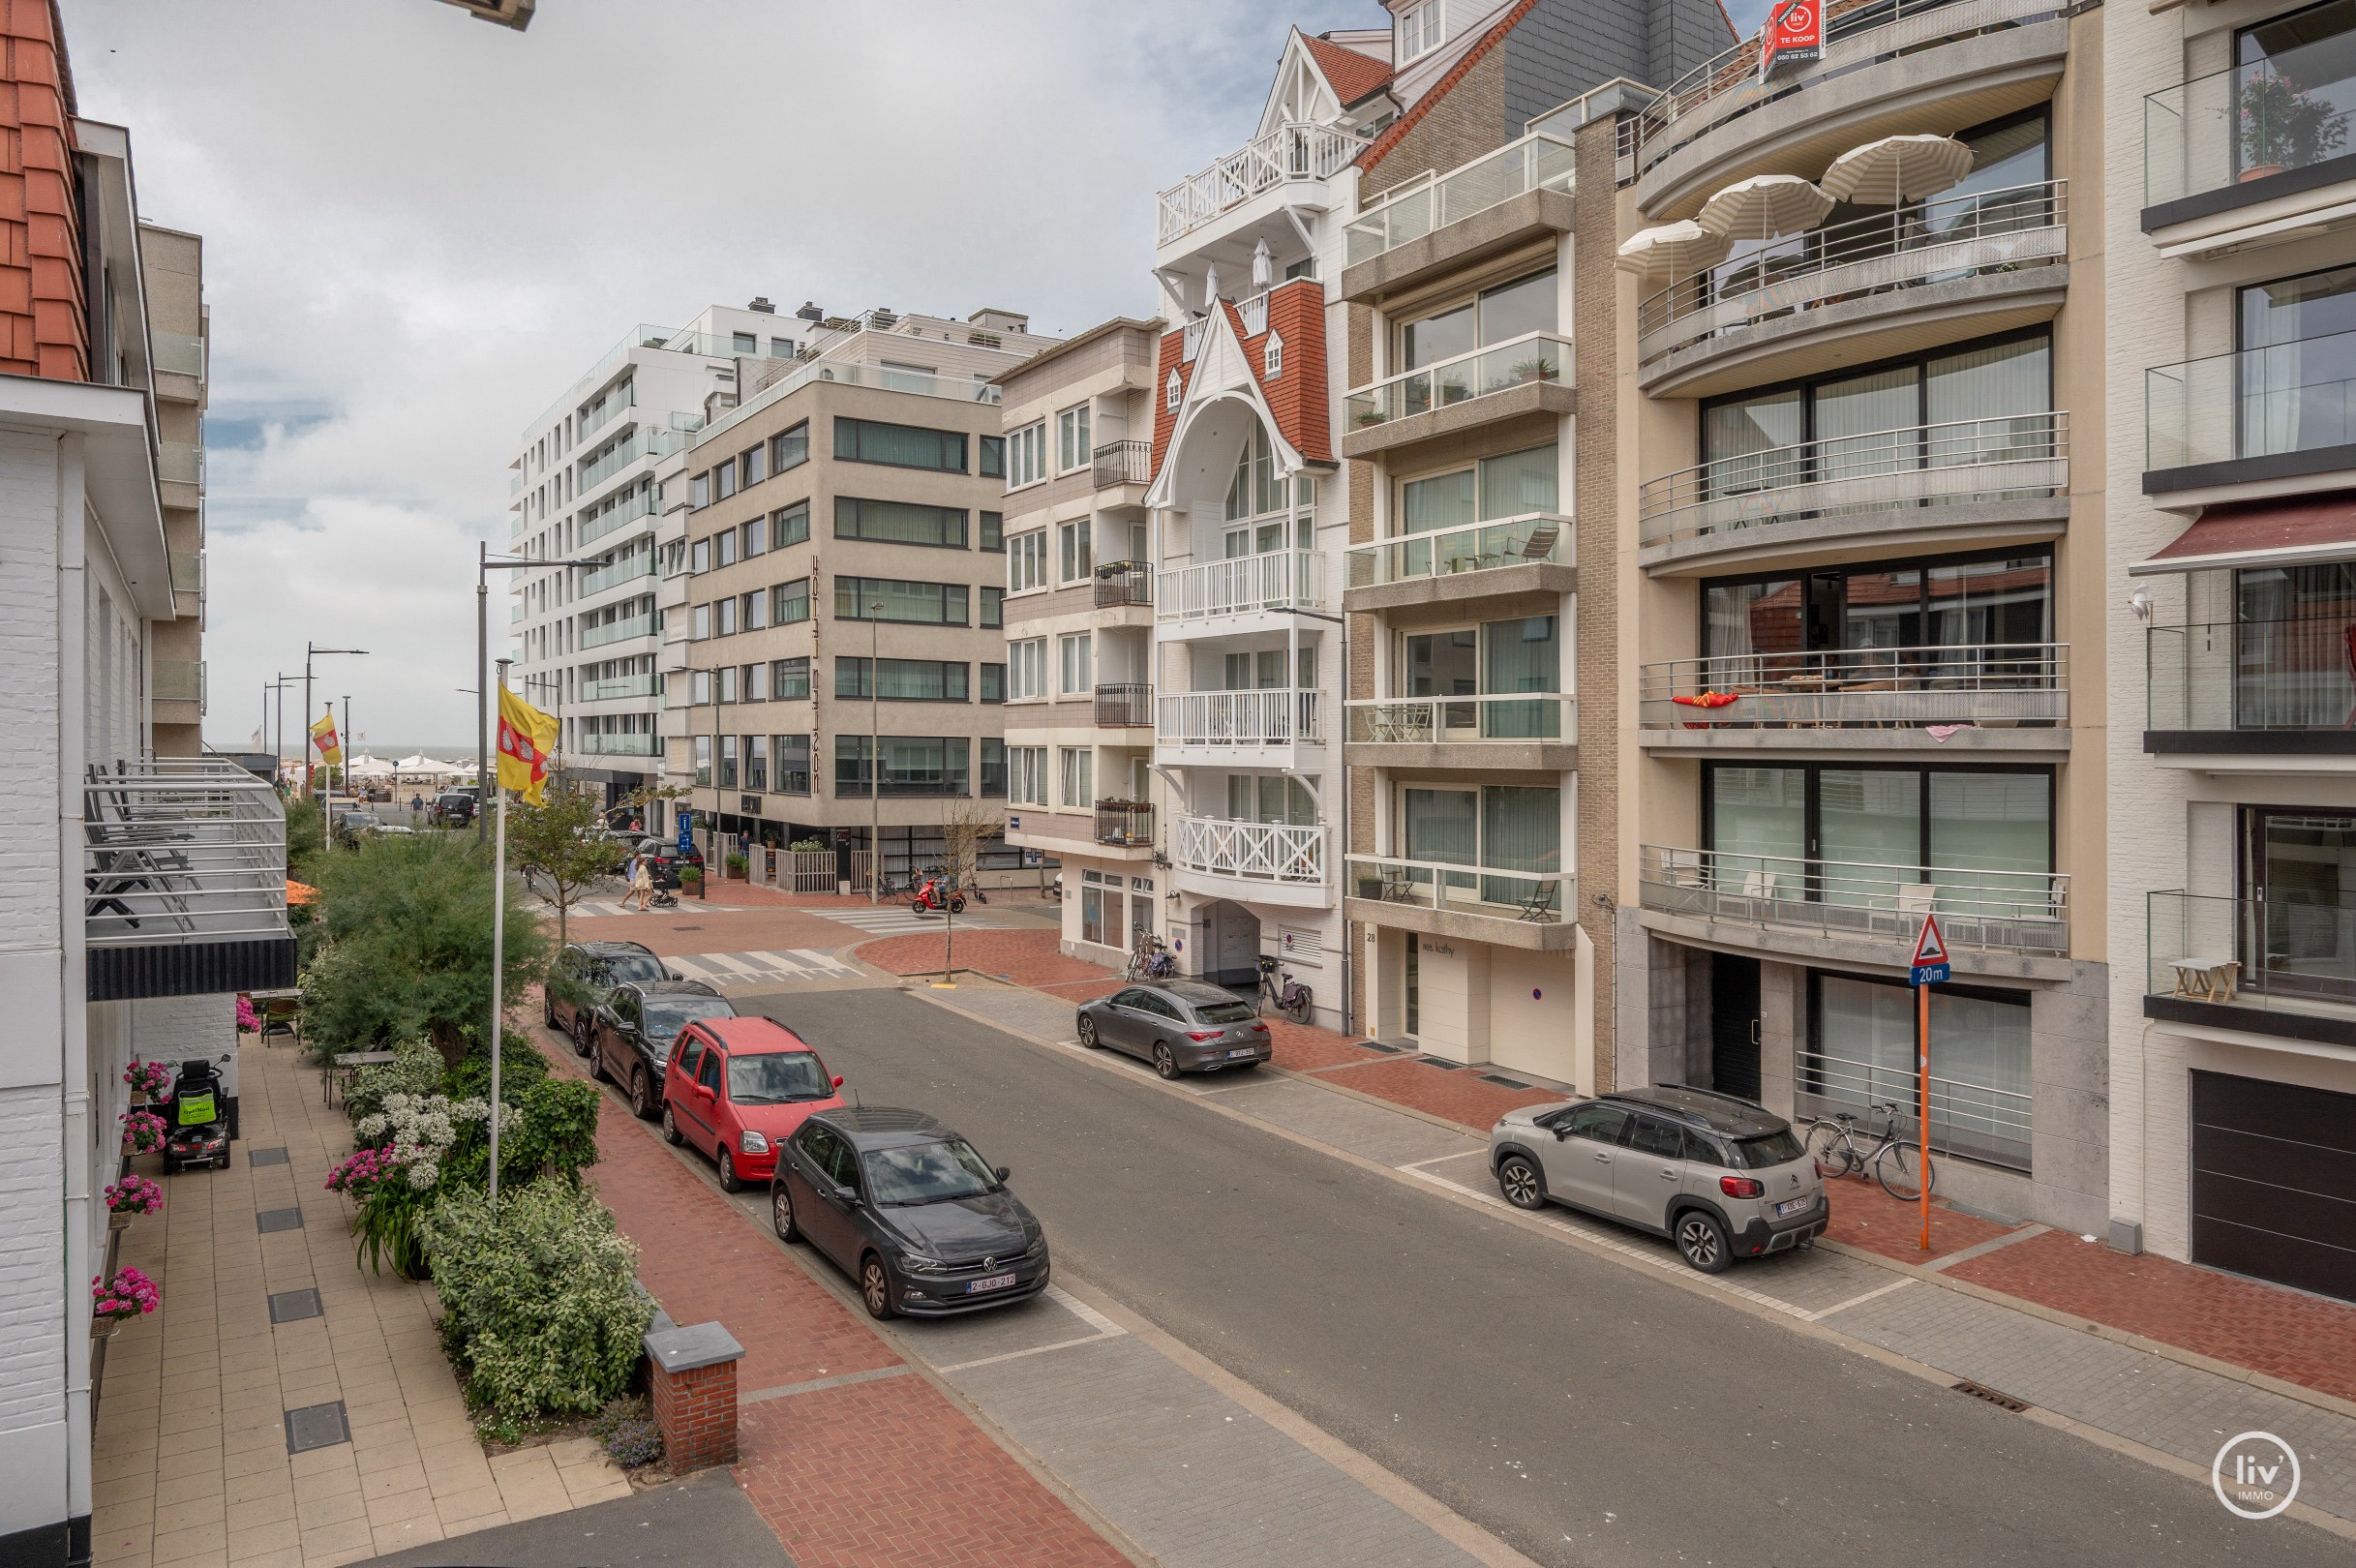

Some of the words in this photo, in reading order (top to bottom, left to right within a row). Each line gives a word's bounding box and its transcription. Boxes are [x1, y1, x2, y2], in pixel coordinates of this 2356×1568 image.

[1367, 933, 1375, 943] 28
[1435, 941, 1455, 958] kathy
[1919, 967, 1943, 982] 20m
